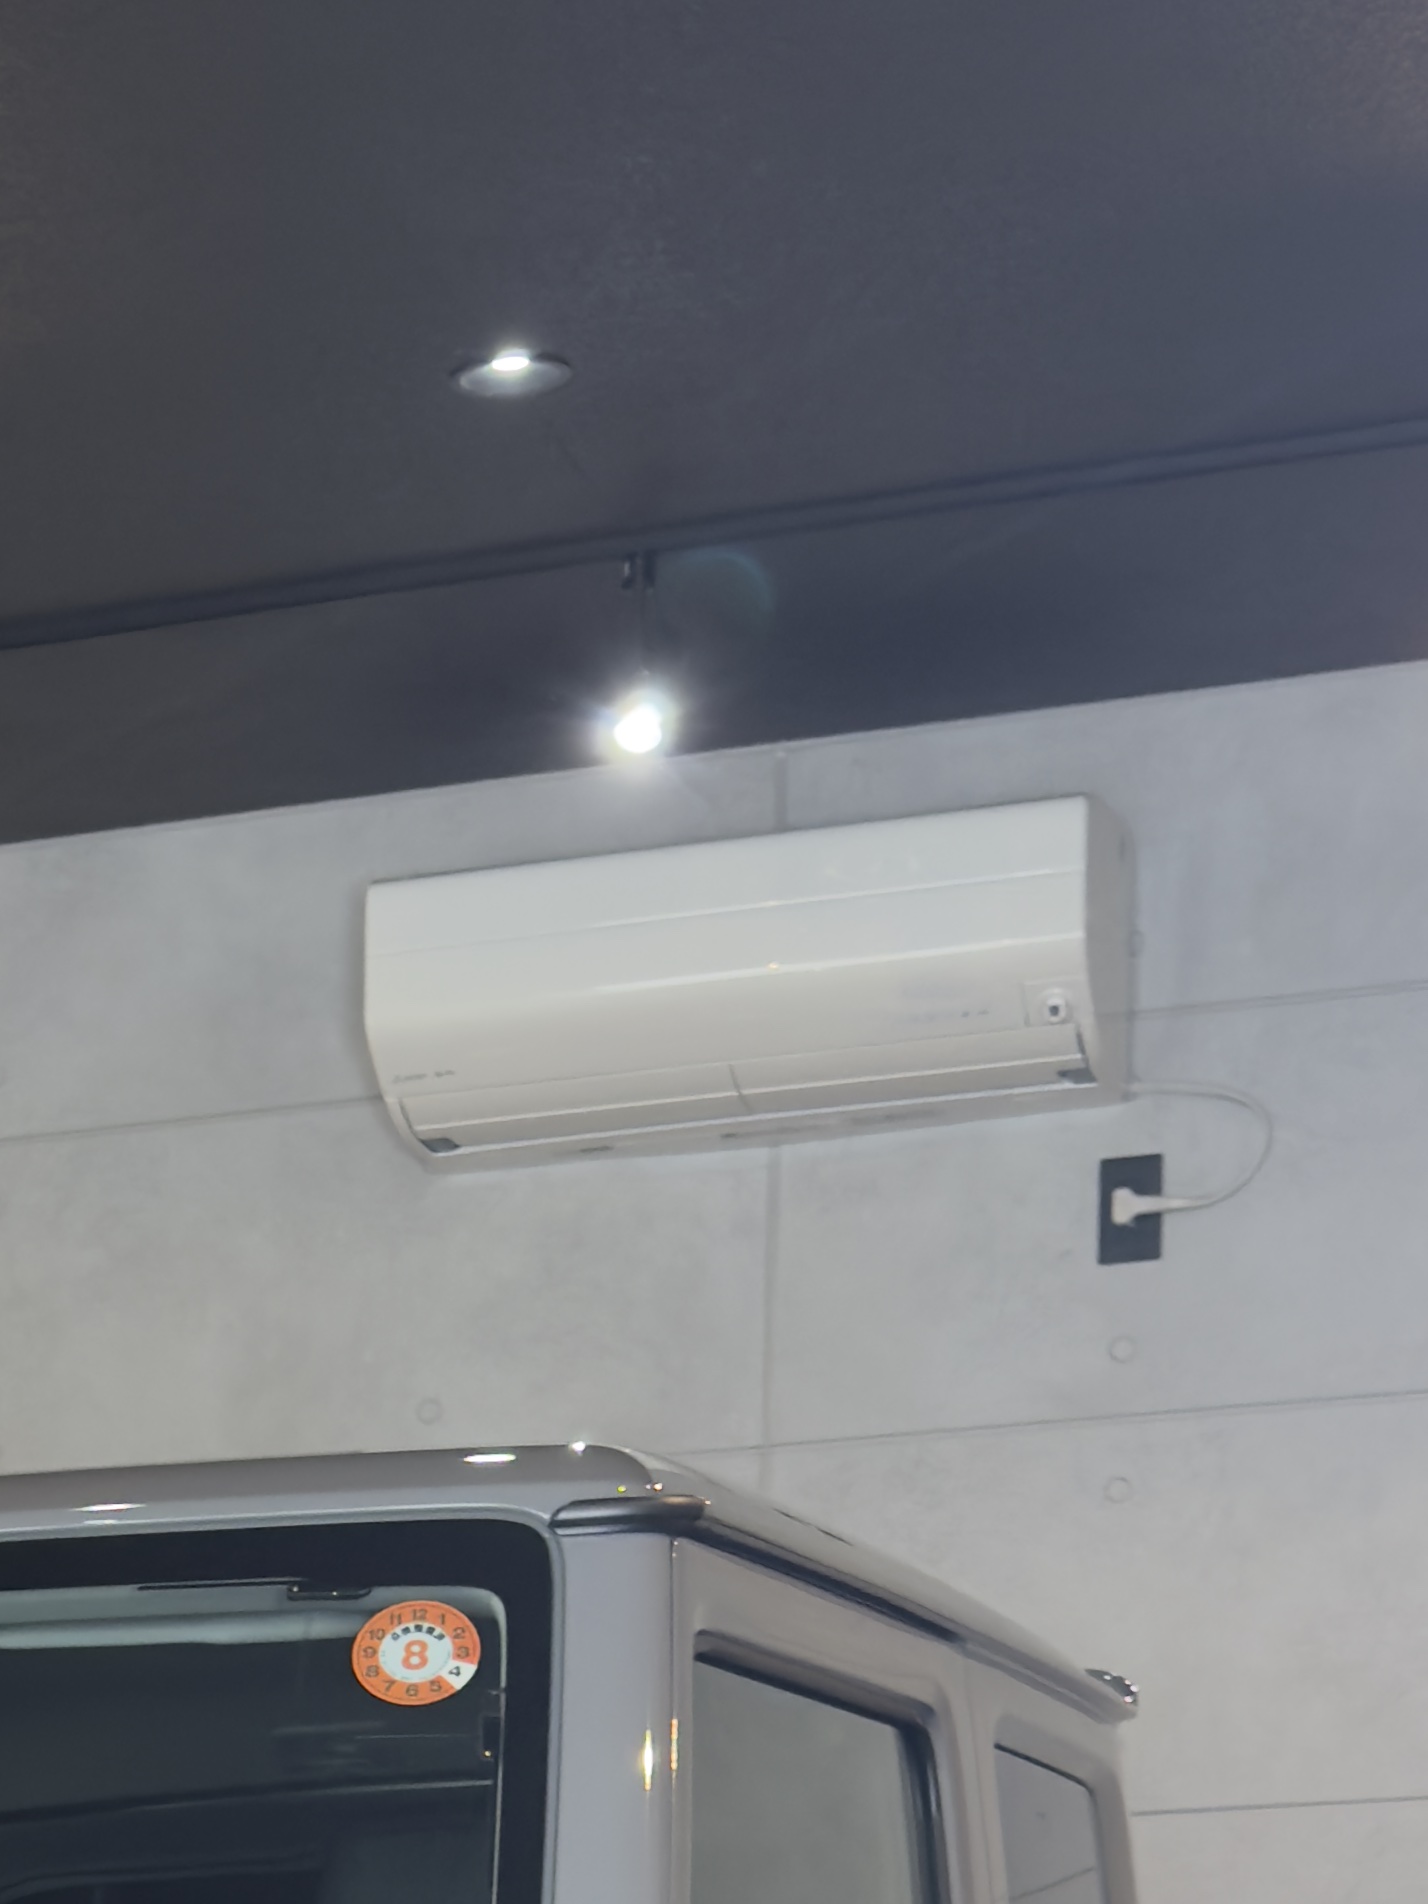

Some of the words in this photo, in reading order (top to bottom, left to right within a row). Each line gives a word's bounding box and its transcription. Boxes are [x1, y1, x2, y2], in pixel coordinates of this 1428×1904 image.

[389, 1612, 402, 1625] 11
[411, 1608, 428, 1620] 12
[439, 1612, 446, 1624] 1
[368, 1628, 386, 1640] 10
[452, 1627, 465, 1639] 2
[363, 1646, 377, 1658] 9
[400, 1639, 429, 1671] 8
[456, 1646, 470, 1659] 3
[365, 1665, 379, 1678] 8
[448, 1665, 462, 1677] 4
[383, 1680, 396, 1692] 7
[405, 1684, 419, 1697] 6
[429, 1680, 442, 1692] 5
